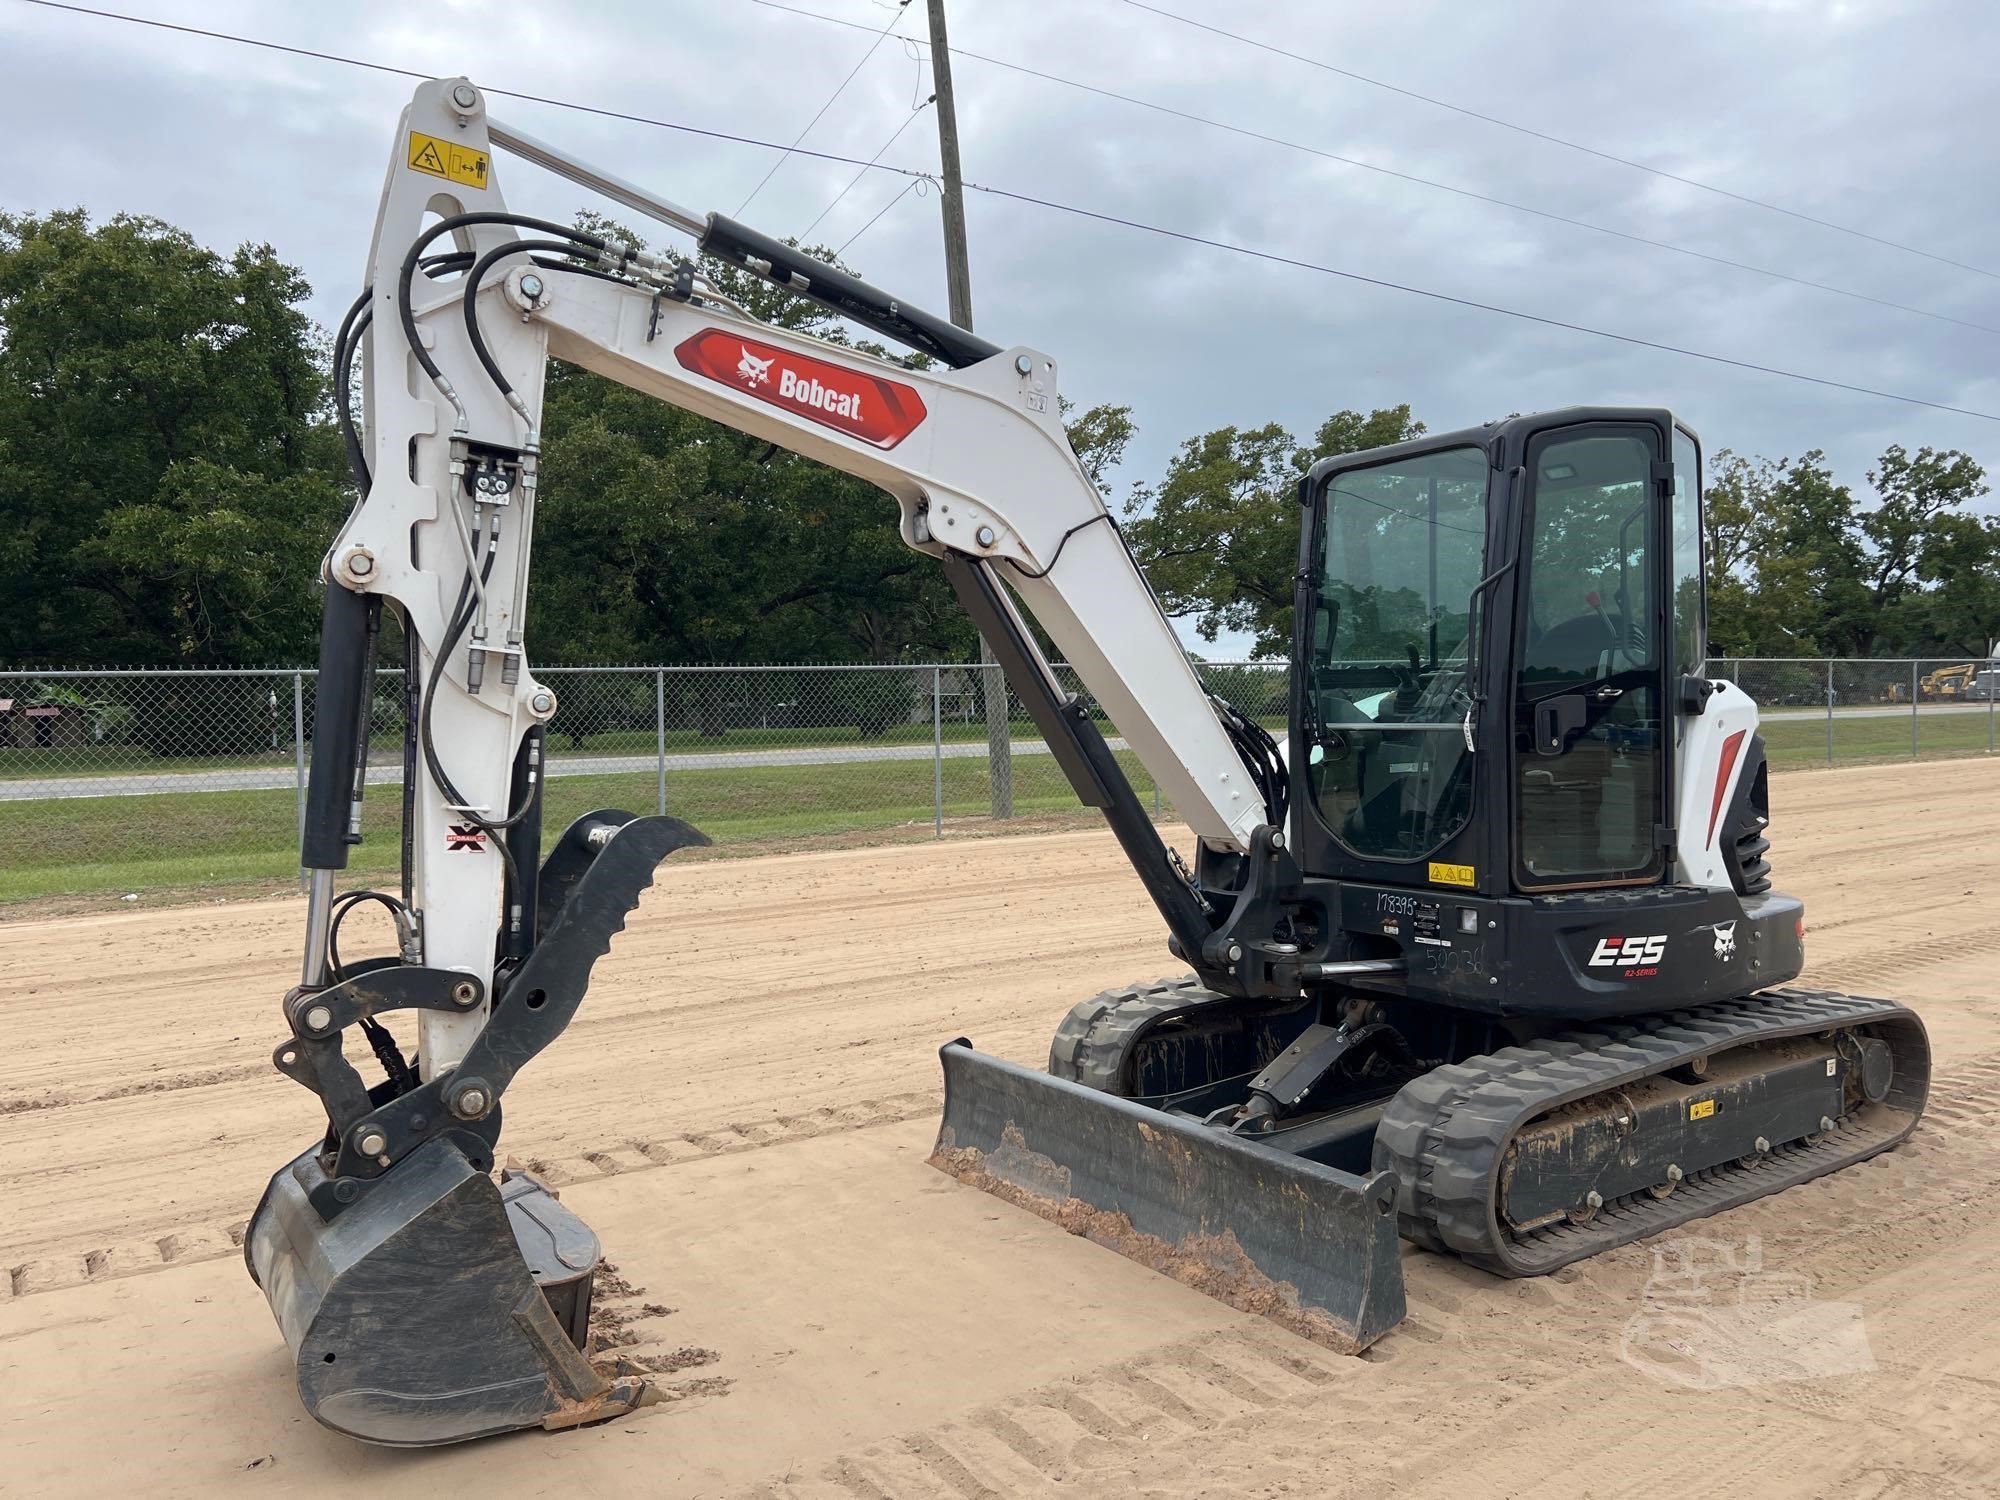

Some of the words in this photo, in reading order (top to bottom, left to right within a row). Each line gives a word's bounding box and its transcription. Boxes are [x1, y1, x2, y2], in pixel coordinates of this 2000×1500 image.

[779, 368, 861, 421] Bobcat
[1376, 892, 1414, 916] 178395
[1587, 934, 1668, 966] E55
[1624, 968, 1658, 977] R2-SERIES
